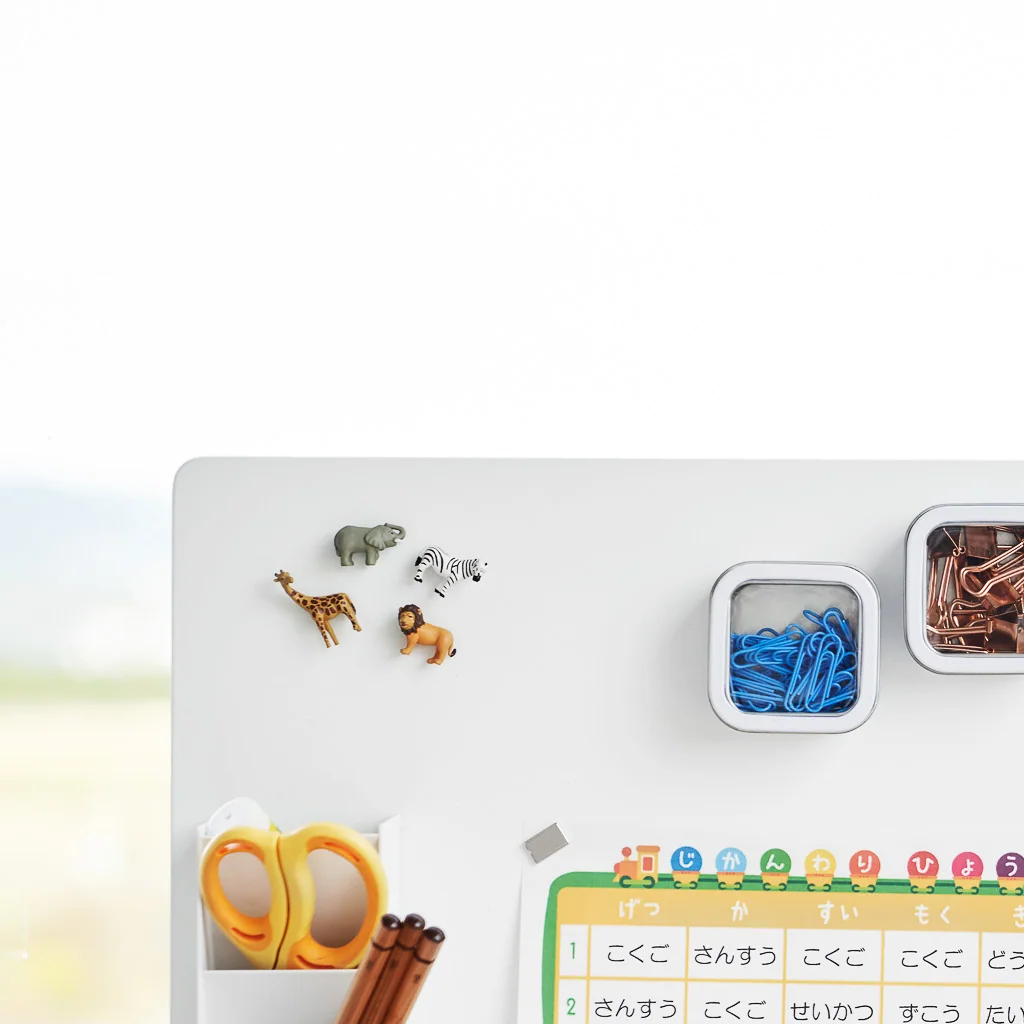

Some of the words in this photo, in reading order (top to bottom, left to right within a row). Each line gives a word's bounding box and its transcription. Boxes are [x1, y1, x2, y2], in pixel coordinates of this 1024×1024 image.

[618, 898, 661, 919] げつ
[730, 900, 749, 922] か
[817, 900, 859, 925] すい
[914, 903, 952, 925] もく
[569, 942, 577, 960] 1
[607, 943, 670, 964] こくご
[694, 944, 776, 966] さんすう
[803, 947, 866, 967] こくご
[901, 948, 964, 969] こくご
[565, 997, 577, 1017] 2
[594, 998, 677, 1019] さんすう
[704, 1000, 767, 1020] こくご
[790, 1001, 872, 1022] せいかつ
[898, 1003, 960, 1024] ずこう
